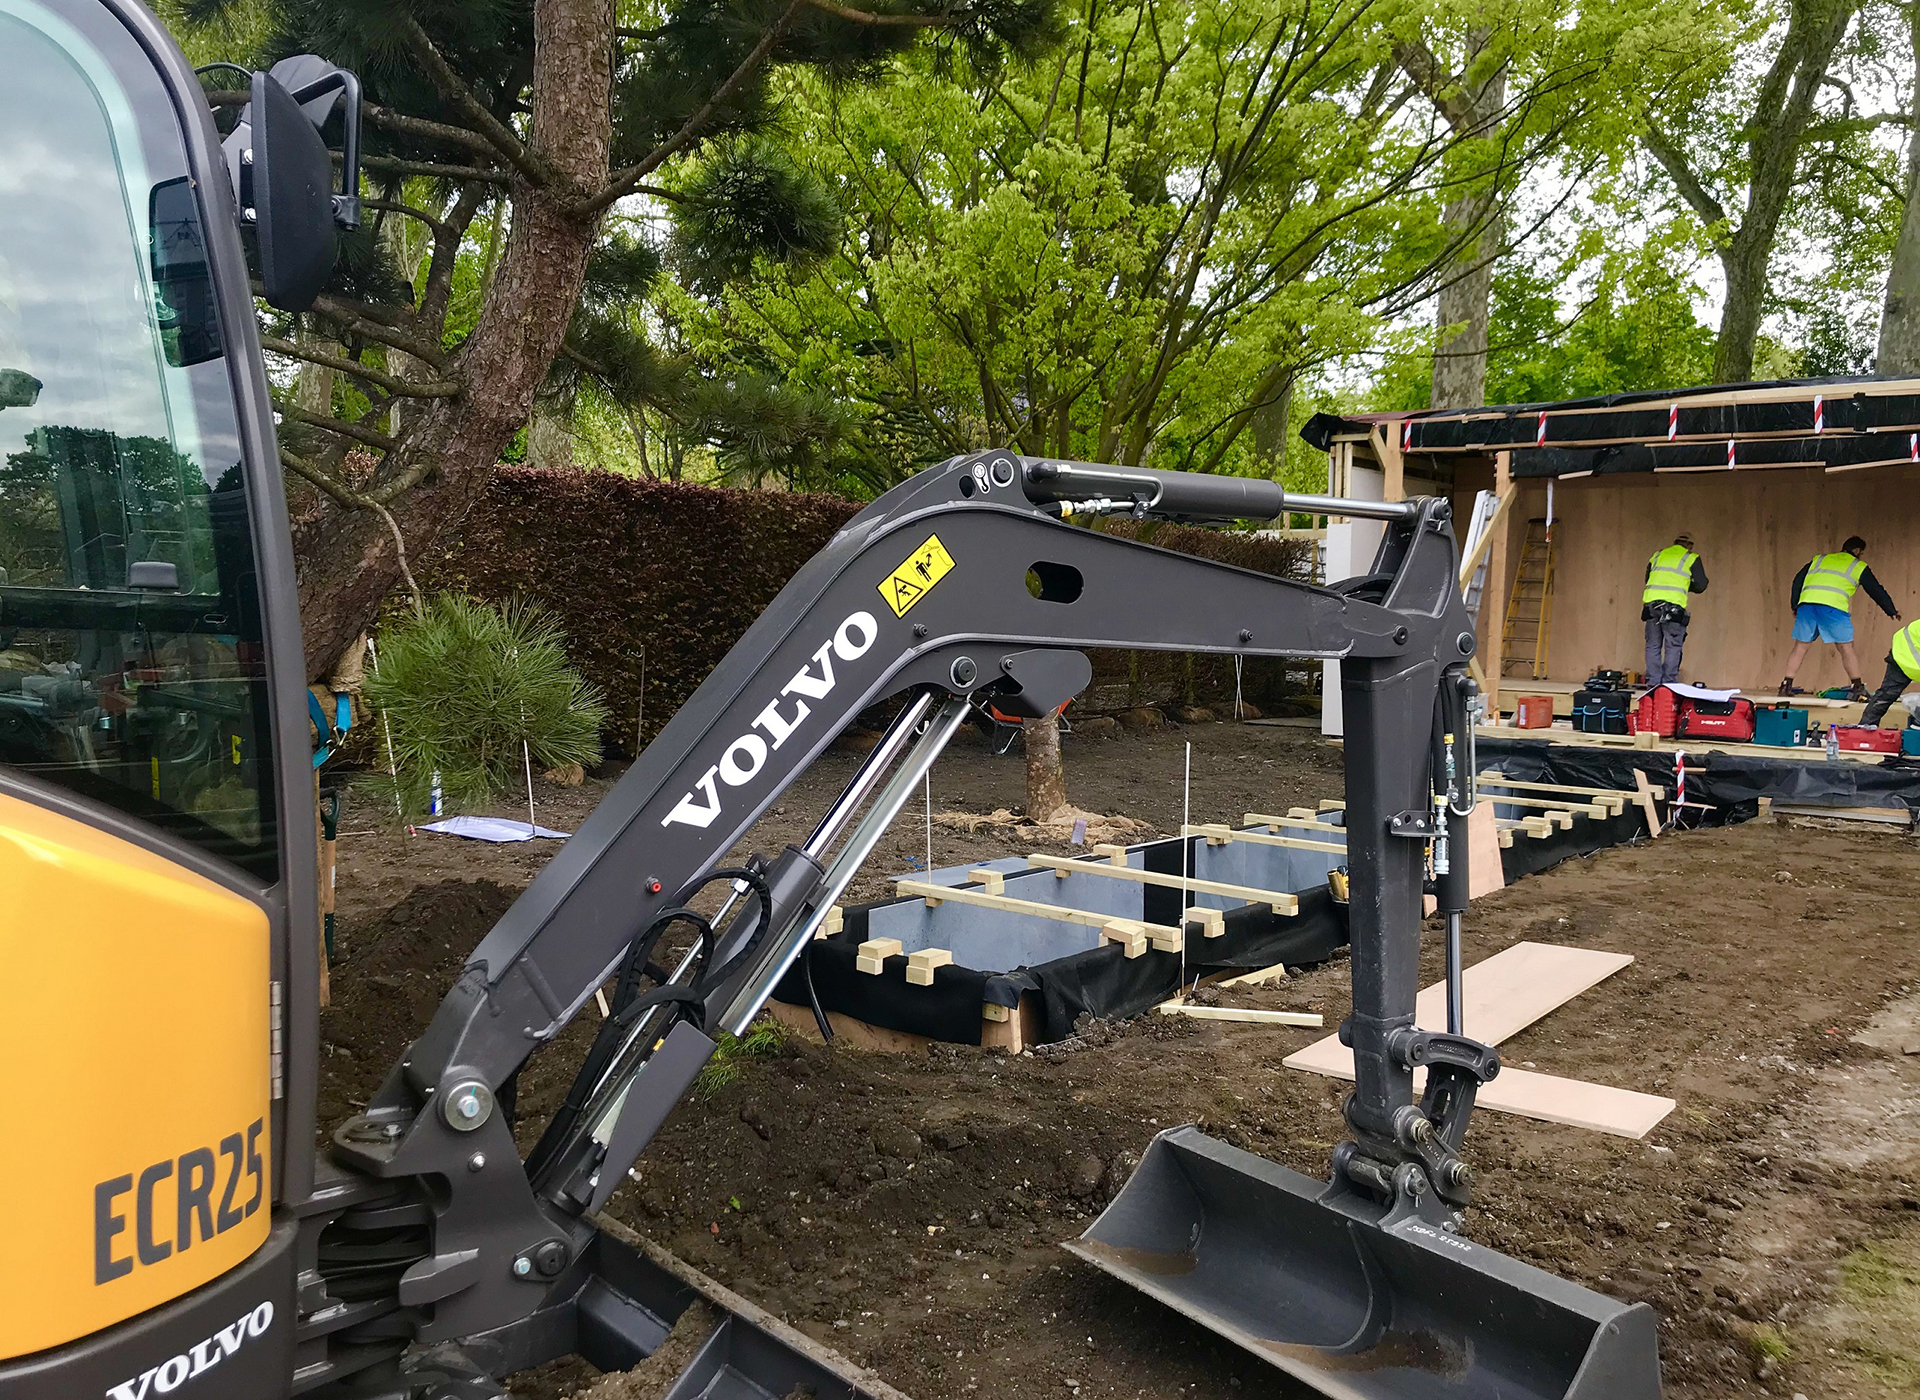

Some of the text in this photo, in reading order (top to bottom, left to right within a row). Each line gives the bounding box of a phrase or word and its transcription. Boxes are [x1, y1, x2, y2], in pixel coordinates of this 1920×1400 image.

[661, 611, 878, 828] VOLVO
[95, 1117, 263, 1286] ECR25
[106, 1301, 274, 1400] VOLVO
